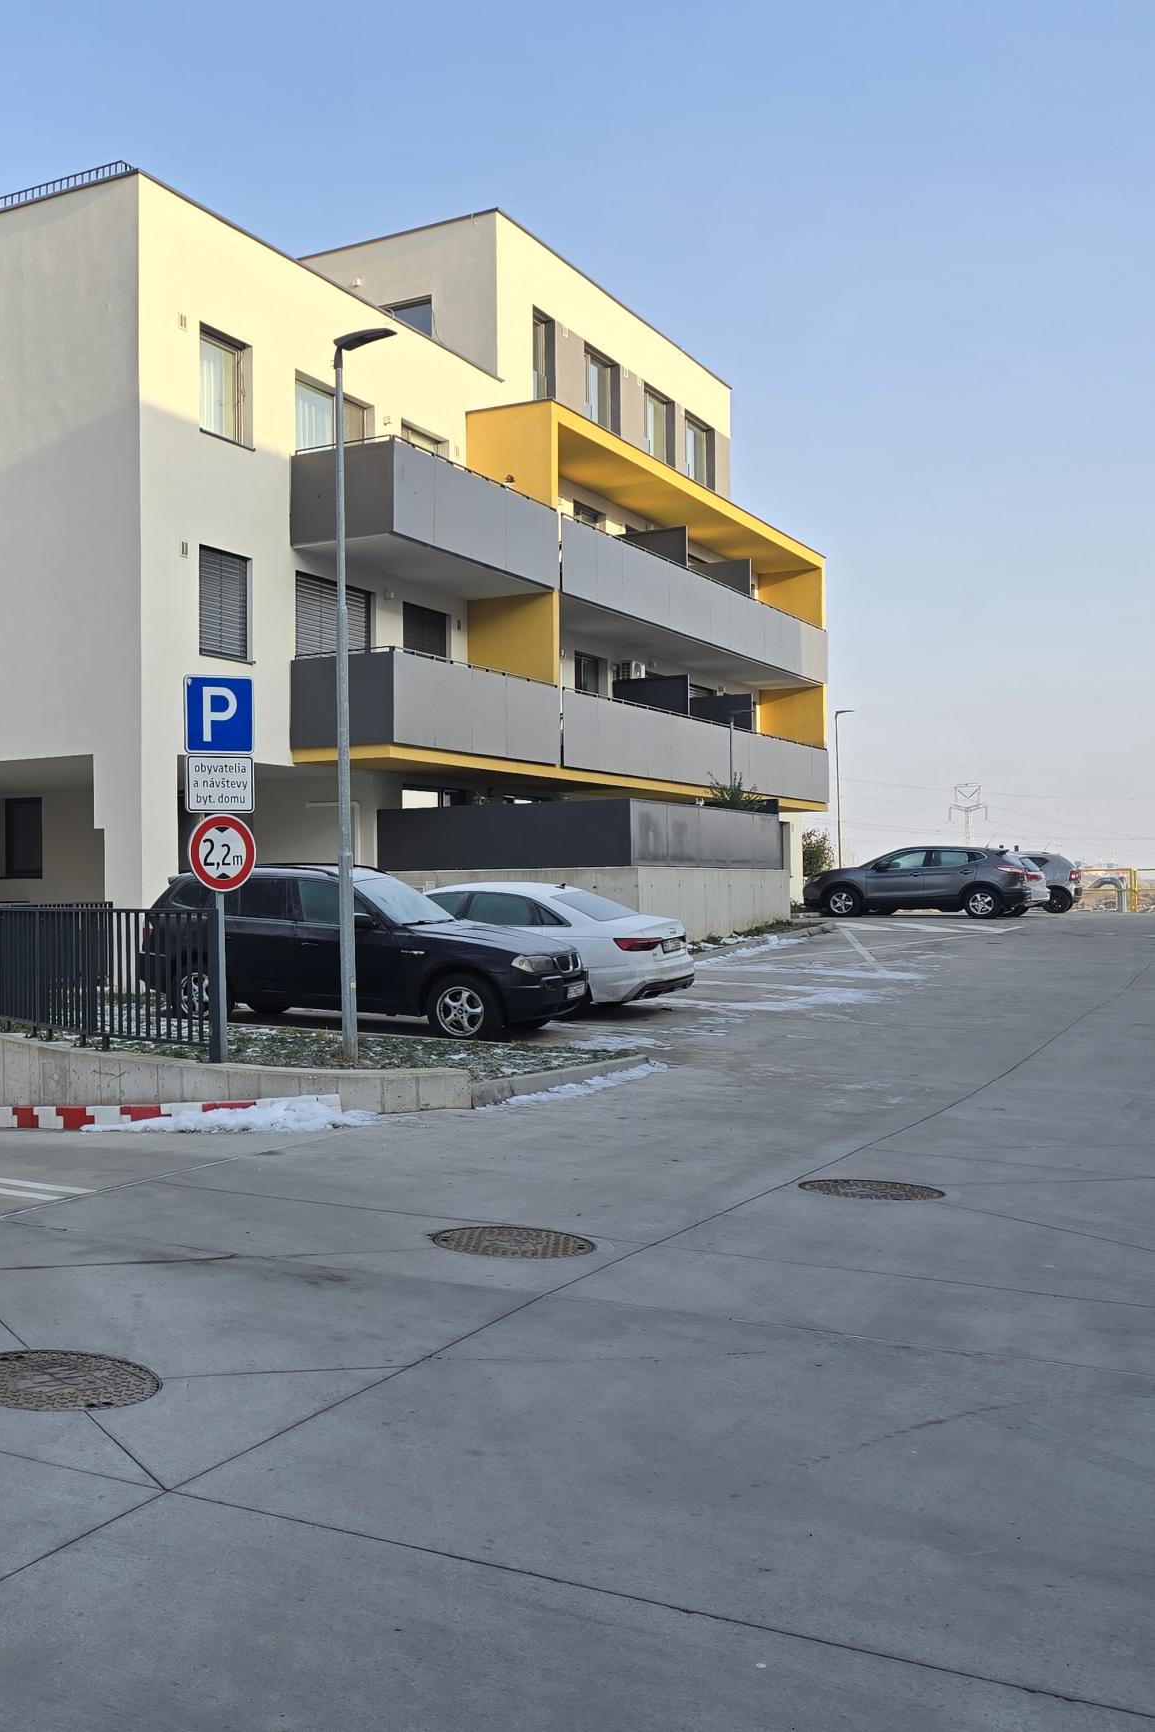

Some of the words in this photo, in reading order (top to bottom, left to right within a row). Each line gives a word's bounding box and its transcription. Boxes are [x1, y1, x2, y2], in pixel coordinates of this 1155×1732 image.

[202, 686, 237, 742] P
[194, 762, 247, 775] obyvatelia
[193, 779, 199, 788] a
[202, 777, 248, 791] návštevy
[196, 793, 215, 805] byt.
[217, 793, 246, 804] domu
